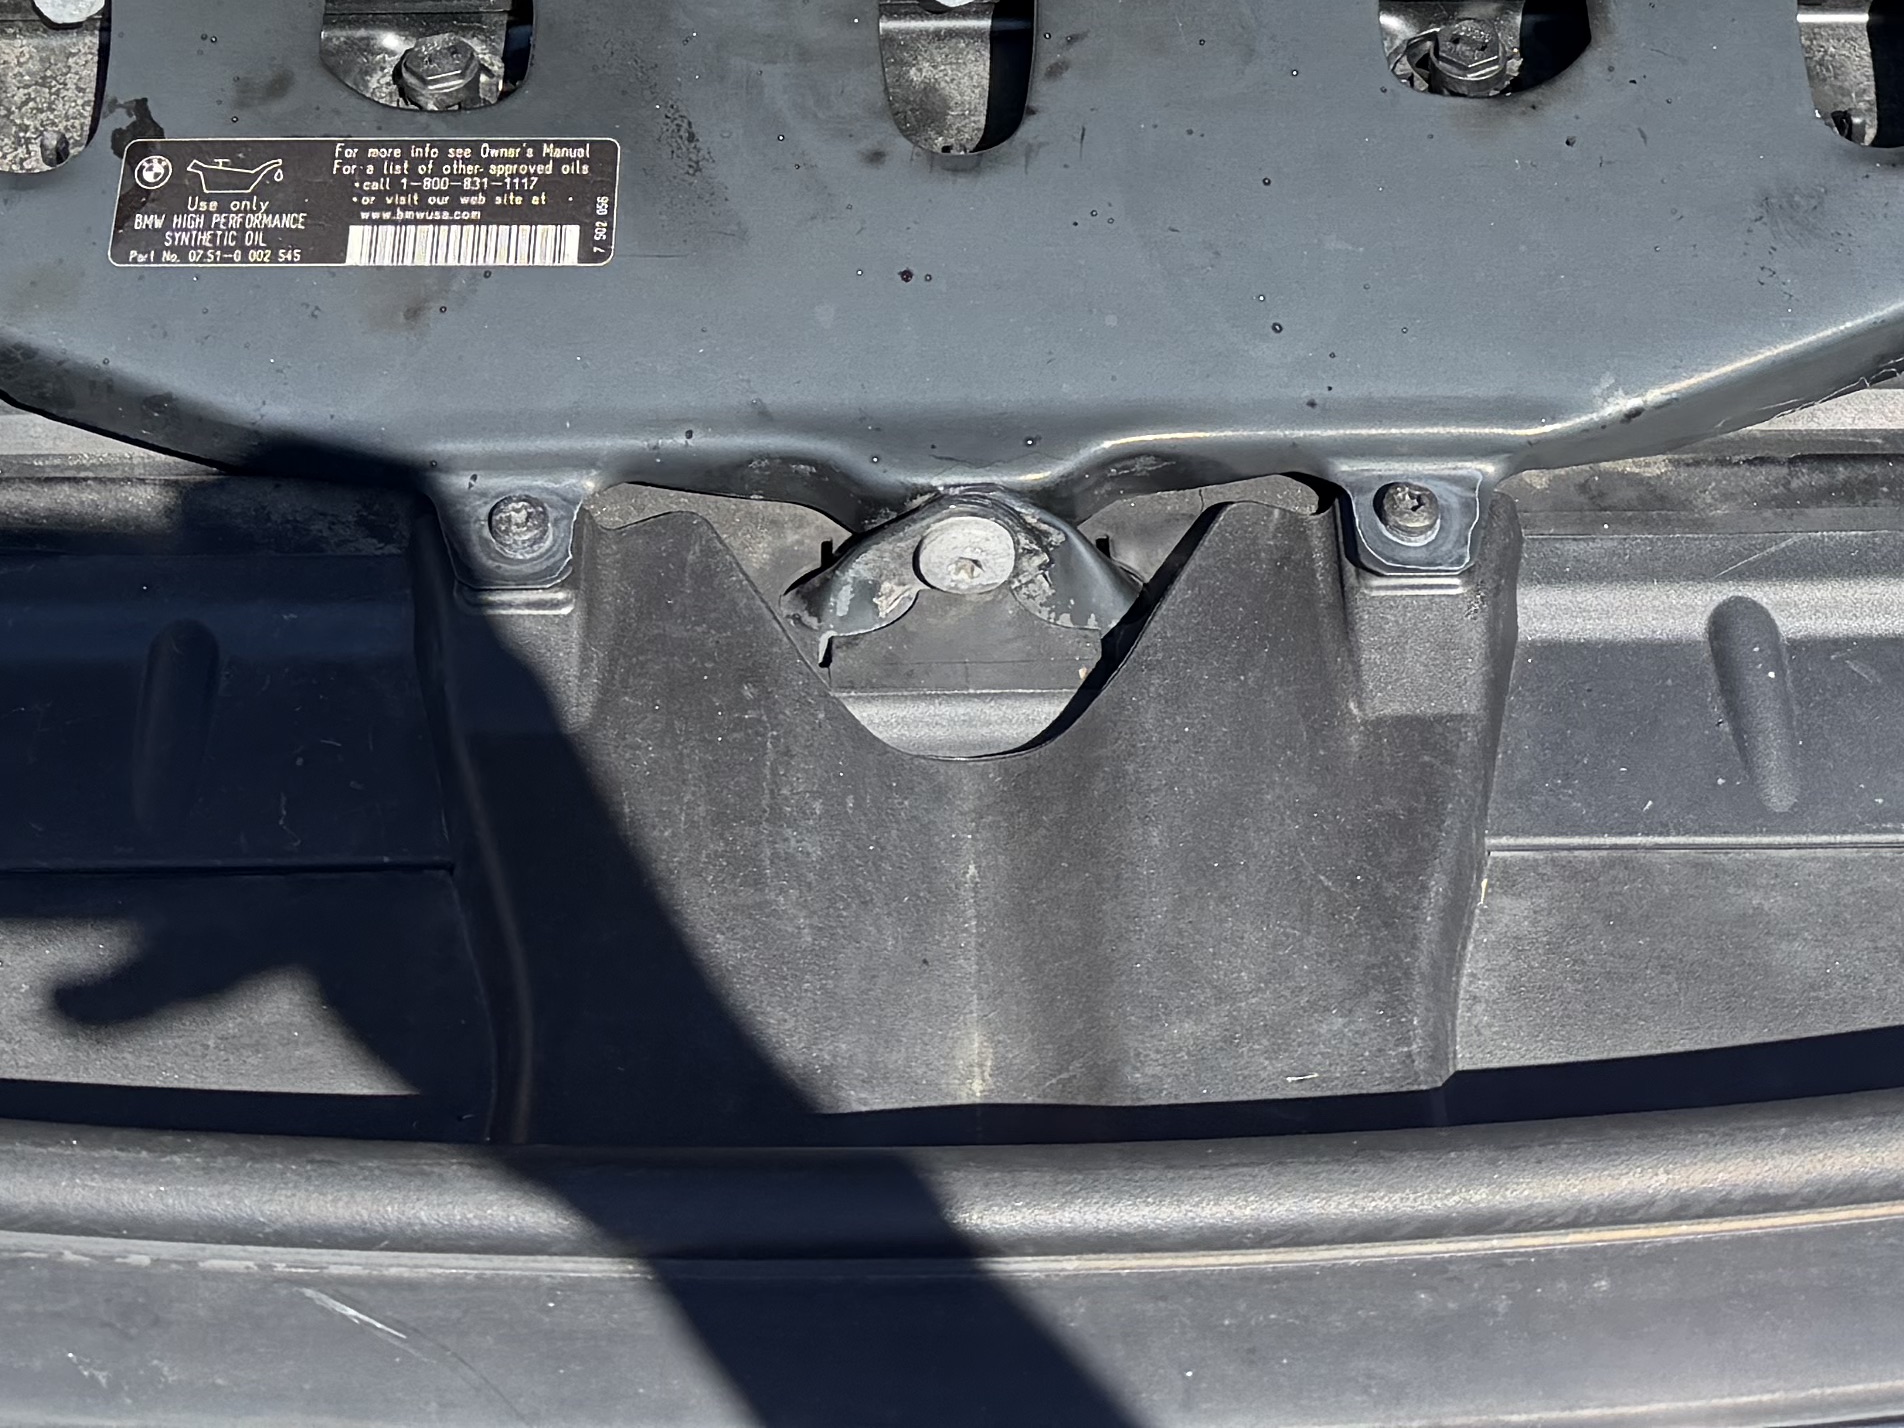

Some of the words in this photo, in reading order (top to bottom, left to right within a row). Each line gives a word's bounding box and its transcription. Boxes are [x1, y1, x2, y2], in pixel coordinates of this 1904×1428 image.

[335, 143, 358, 158] For
[368, 148, 401, 158] more
[411, 143, 439, 158] info
[448, 148, 471, 158] see
[481, 143, 533, 158] Owner's
[543, 144, 589, 158] Manual
[333, 161, 357, 174] For
[366, 165, 374, 174] a
[384, 161, 408, 174] list
[418, 161, 433, 174] of
[489, 161, 552, 176] approved
[561, 161, 589, 174] oils
[363, 177, 390, 190] call
[401, 177, 538, 190] 1-800-831-1117
[188, 196, 218, 211] Use
[230, 196, 269, 214] only
[361, 196, 375, 205] or
[386, 194, 418, 206] visit
[428, 196, 449, 205] our
[460, 194, 486, 205] web
[495, 194, 523, 205] site
[532, 194, 545, 205] at
[134, 214, 165, 229] BMW
[173, 214, 204, 230] HIGH
[211, 213, 307, 229] PERFORMANCE
[360, 209, 480, 221] www.bmwusa.com
[164, 230, 237, 247] SYNTHETIC
[245, 231, 267, 246] OIL
[129, 249, 154, 262] Part
[162, 250, 180, 263] No.
[248, 249, 271, 262] 002
[278, 249, 301, 262] 545
